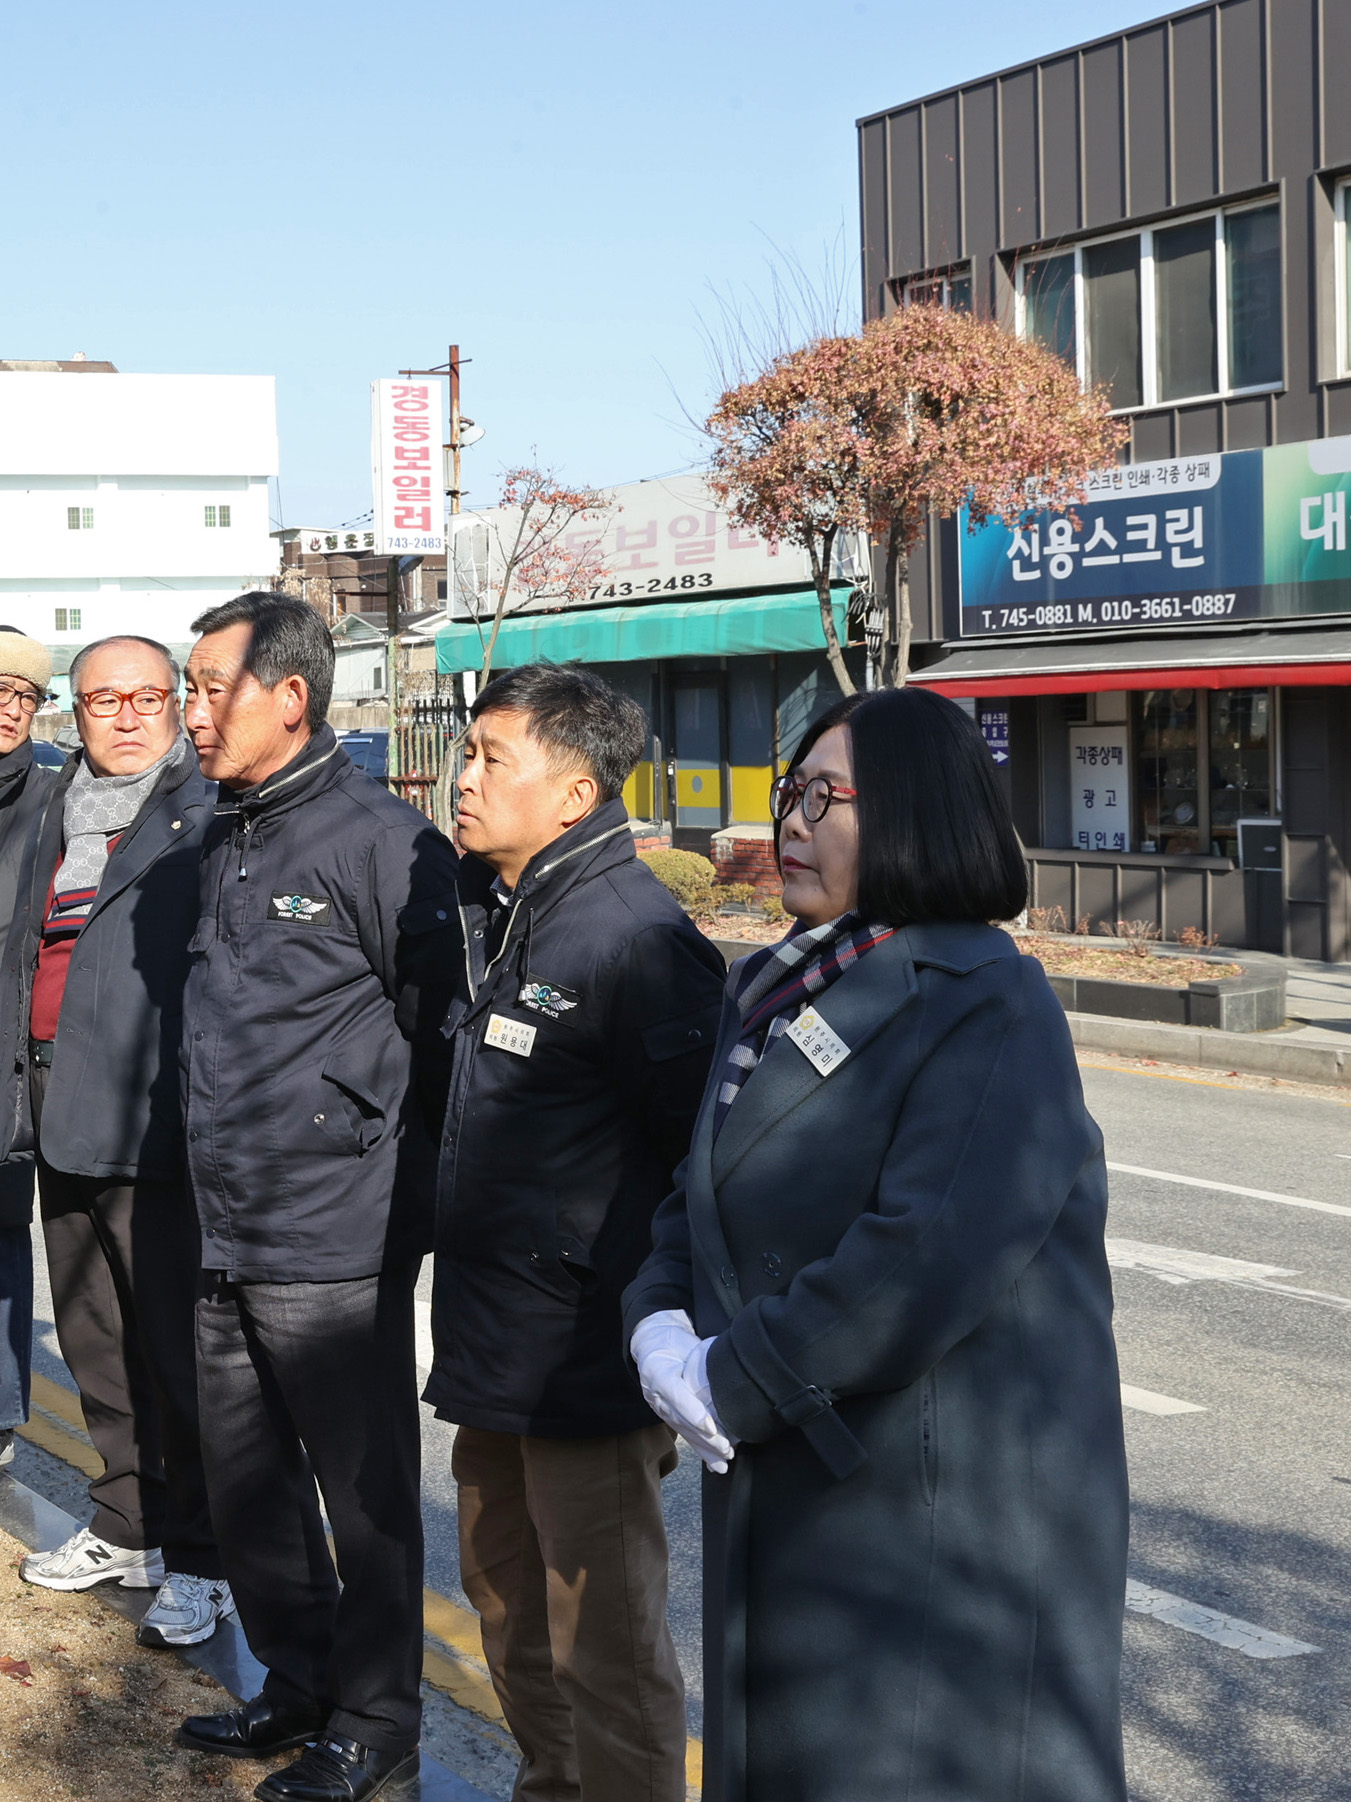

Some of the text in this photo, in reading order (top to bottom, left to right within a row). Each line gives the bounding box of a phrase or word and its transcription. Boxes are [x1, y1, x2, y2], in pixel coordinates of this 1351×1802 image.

[391, 385, 432, 532] 경동보일러
[1089, 471, 1123, 491] 스크린
[1185, 461, 1211, 482] 상패
[1300, 490, 1351, 551] 대
[387, 537, 442, 549] 743-2483
[1006, 506, 1205, 581] 신용스크린
[590, 573, 714, 599] 743-2483
[982, 593, 1237, 629] T. 745-0881 M. 010-3661-0887
[1075, 746, 1123, 766] 각종상패
[1083, 789, 1117, 809] 광고
[541, 1006, 559, 1018] POLICE
[802, 1034, 834, 1067] 심영미
[85, 1544, 113, 1565] N
[208, 1587, 224, 1607] N
